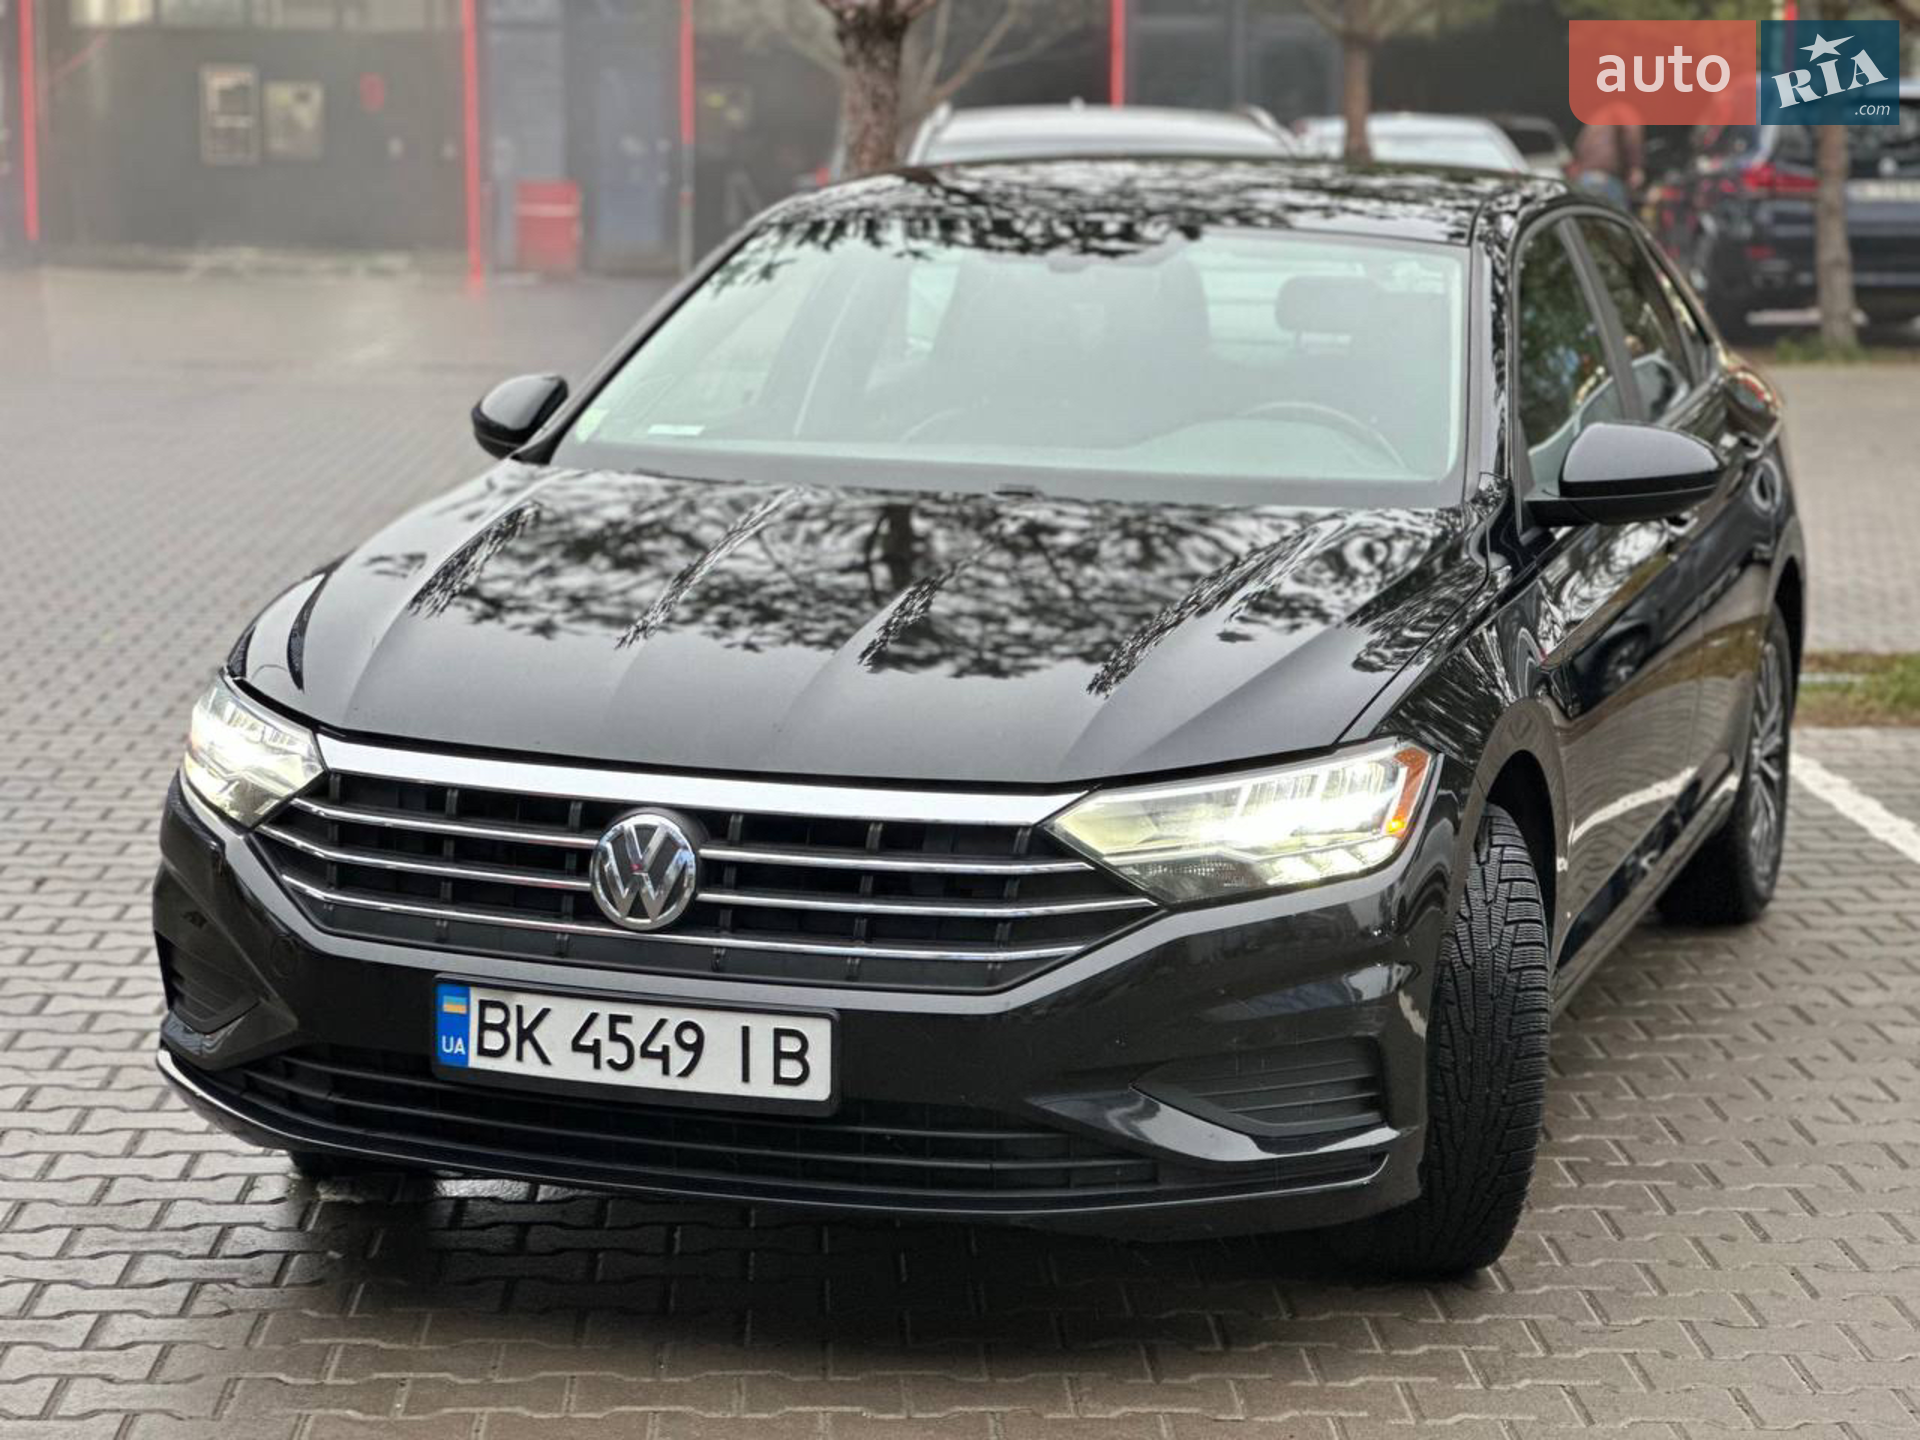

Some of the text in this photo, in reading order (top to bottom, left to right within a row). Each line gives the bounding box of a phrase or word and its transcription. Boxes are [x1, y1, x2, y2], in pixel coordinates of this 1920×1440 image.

[594, 815, 695, 929] VW
[441, 1036, 467, 1056] UA
[476, 998, 811, 1087] BK 4549 IB
